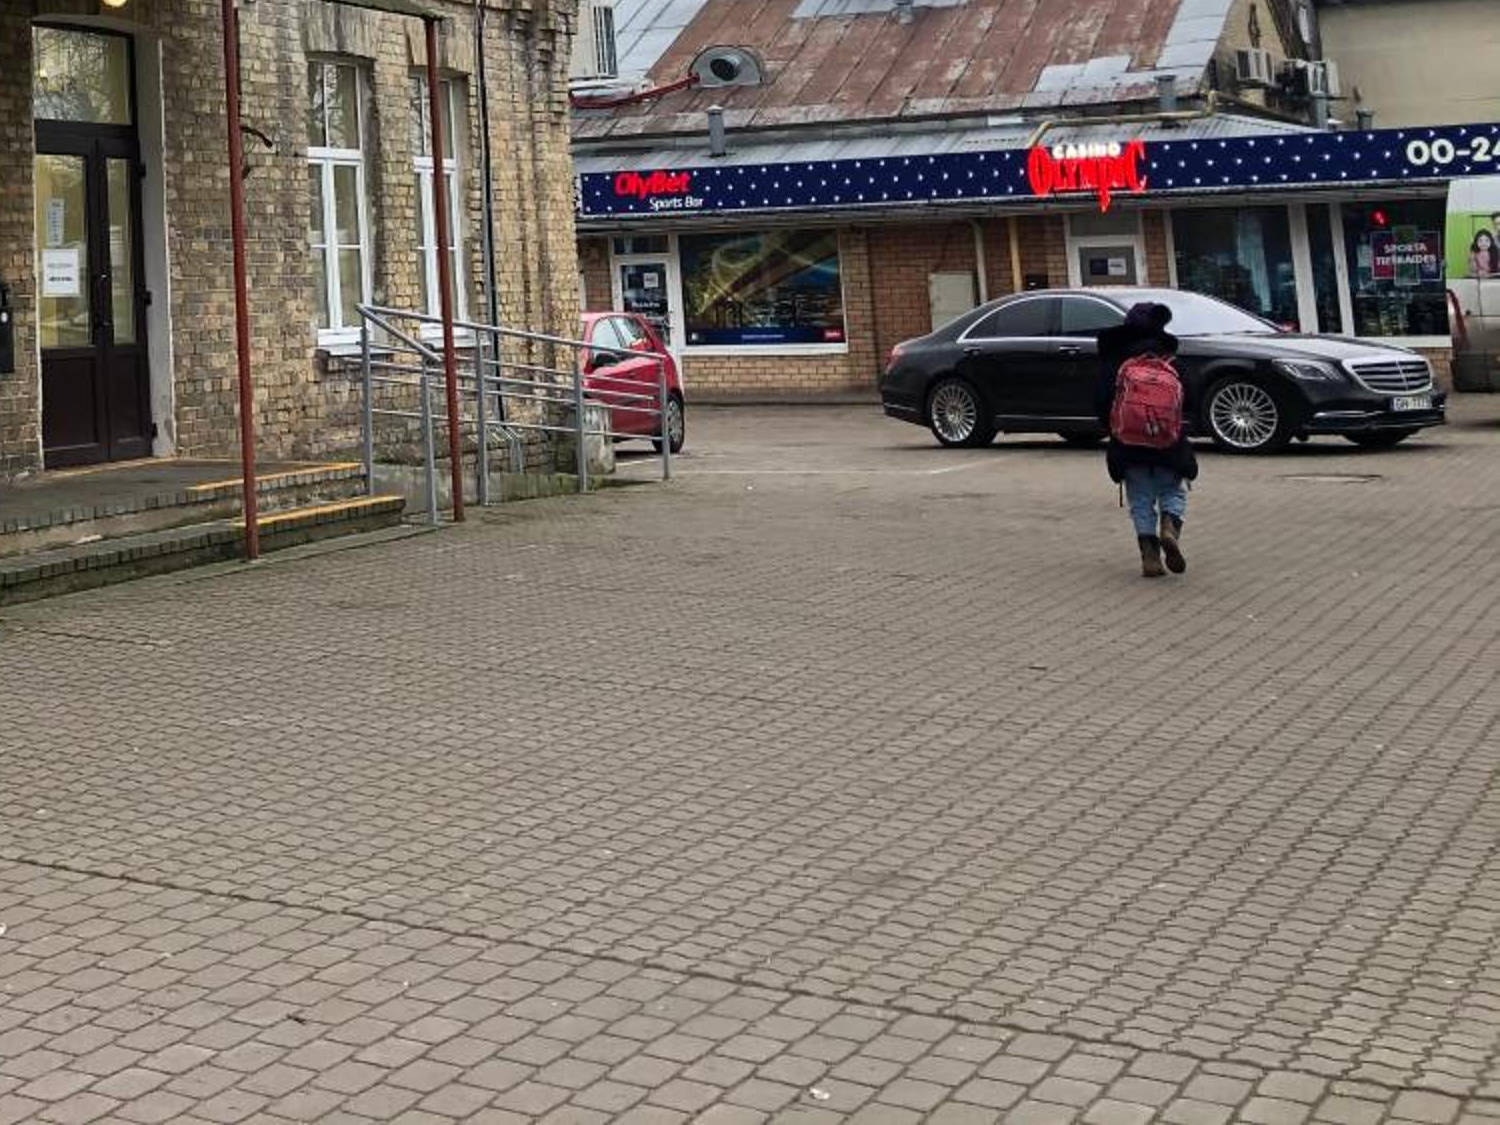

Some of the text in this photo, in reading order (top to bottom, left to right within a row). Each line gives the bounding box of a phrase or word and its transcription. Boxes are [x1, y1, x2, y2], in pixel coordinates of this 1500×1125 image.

[1052, 141, 1121, 160] CASINO
[614, 171, 691, 200] OlyBet
[649, 196, 704, 211] Sports Bar
